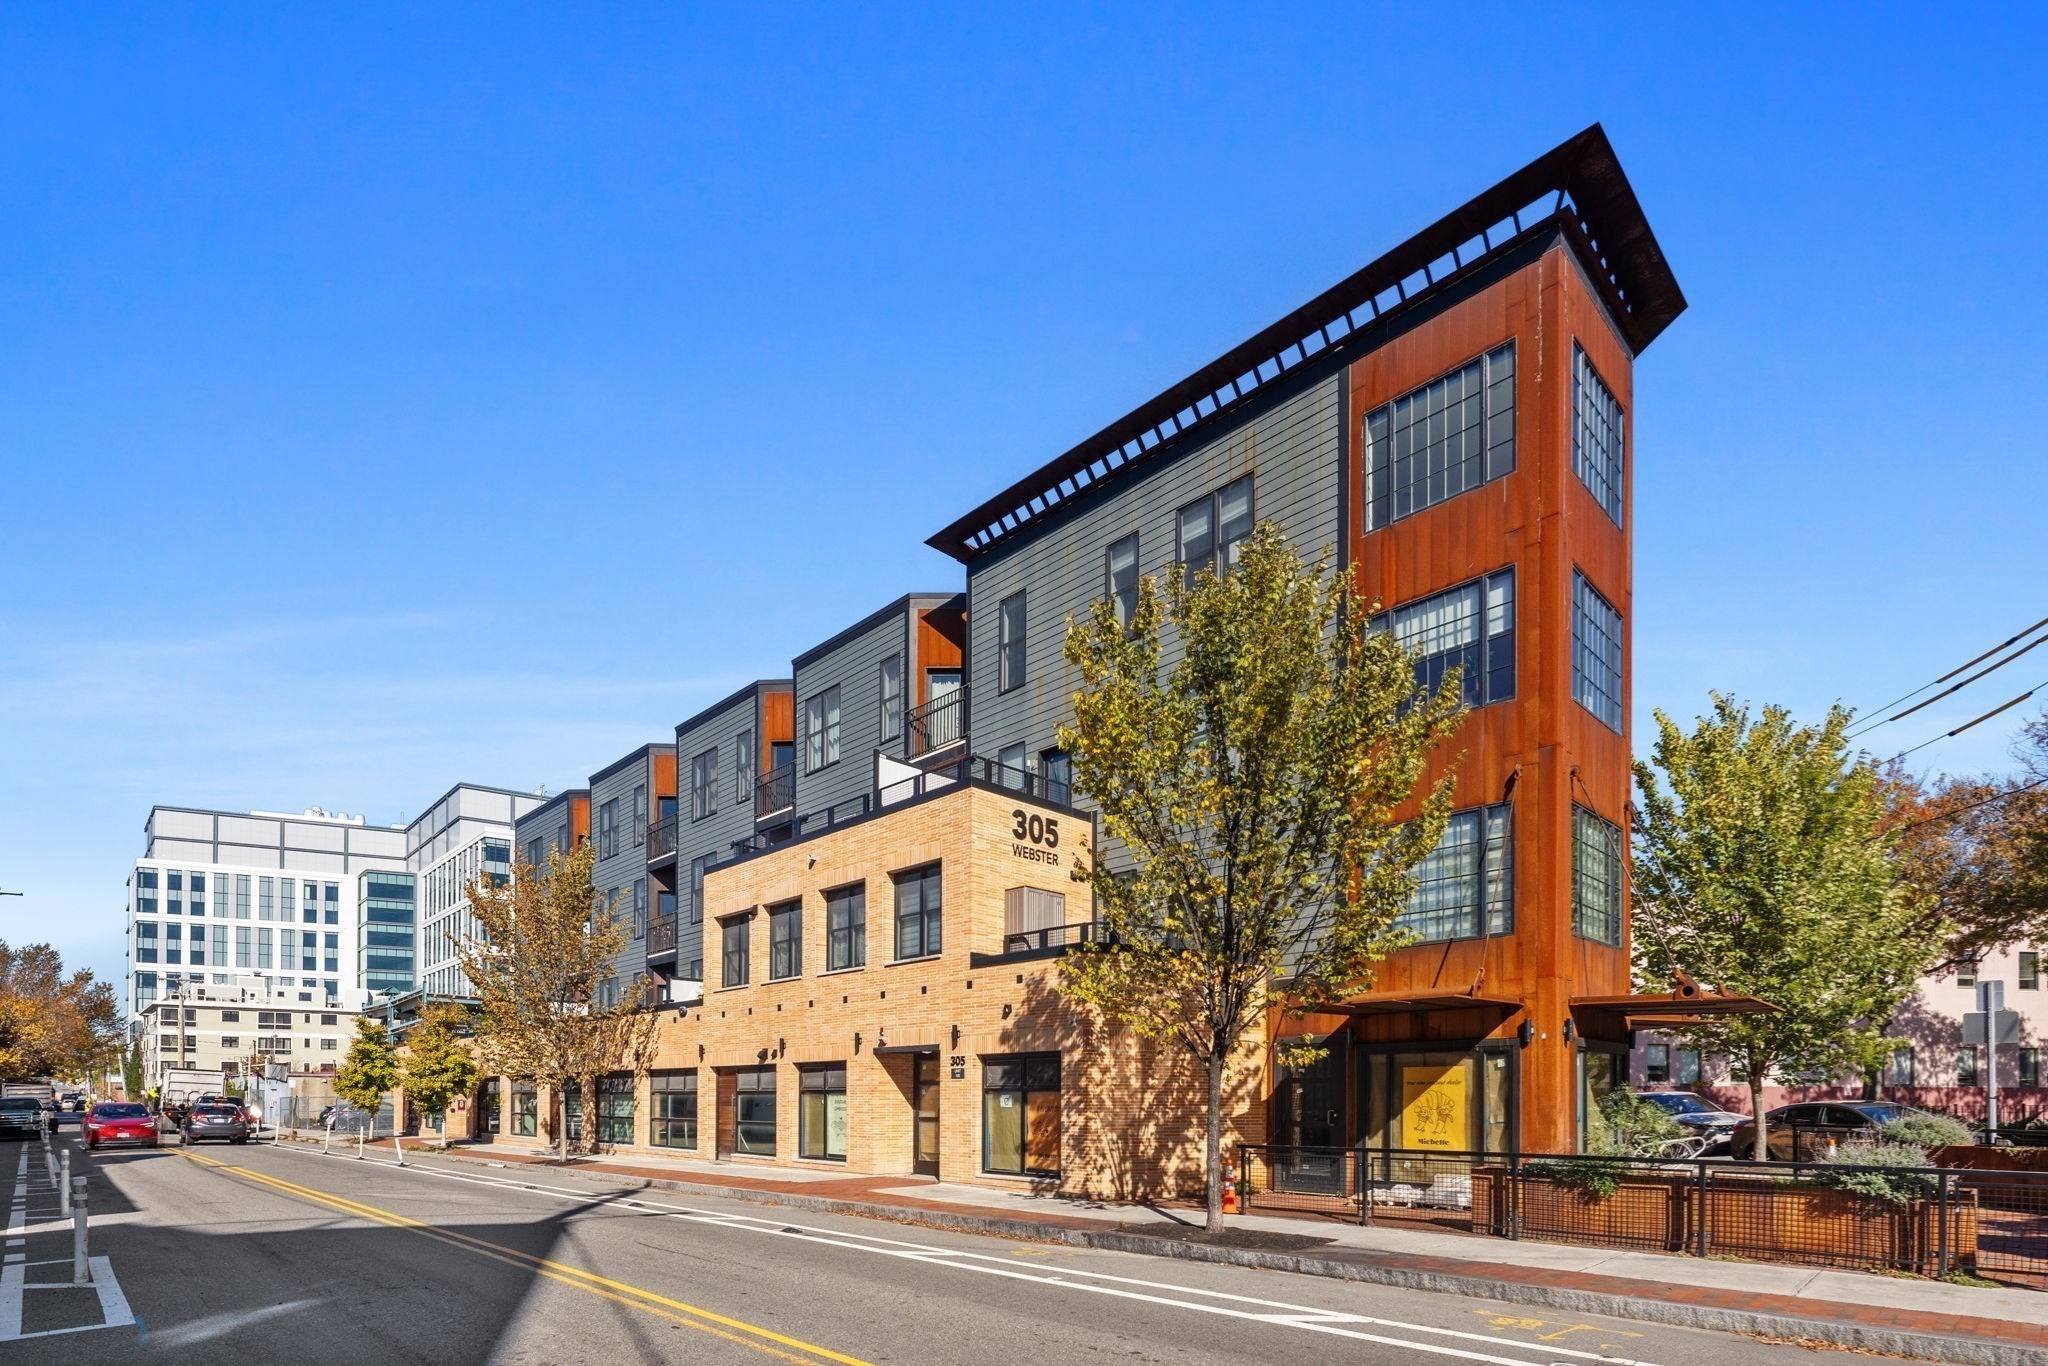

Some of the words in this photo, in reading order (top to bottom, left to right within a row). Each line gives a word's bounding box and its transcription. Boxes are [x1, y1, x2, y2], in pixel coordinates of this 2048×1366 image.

[1012, 809, 1059, 848] 305
[1012, 843, 1059, 866] WEBSTER
[950, 1055, 966, 1067] 305
